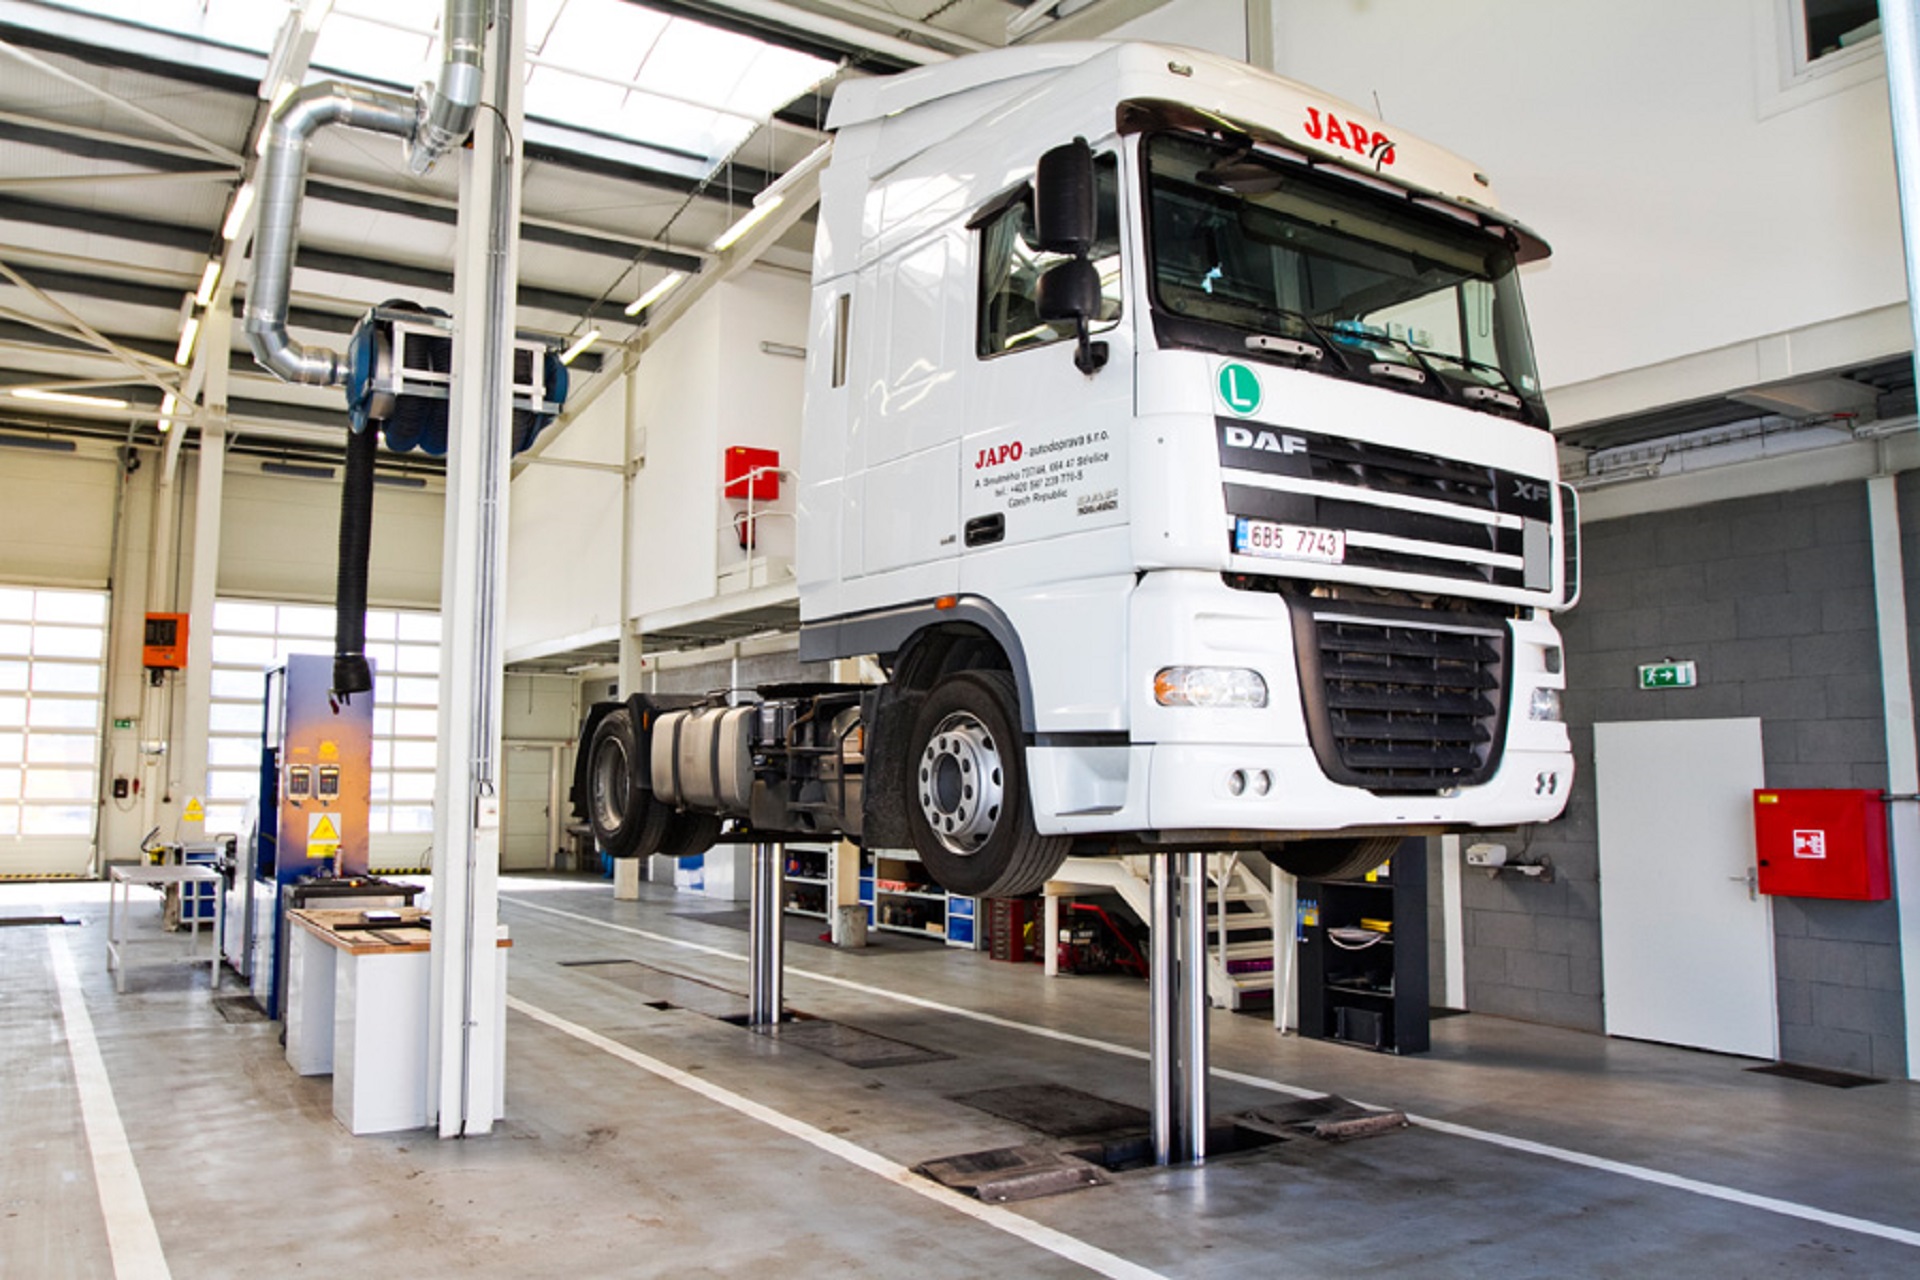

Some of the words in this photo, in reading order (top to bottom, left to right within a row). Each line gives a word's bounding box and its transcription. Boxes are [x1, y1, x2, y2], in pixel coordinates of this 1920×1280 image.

[1304, 107, 1395, 165] JAPO
[1228, 368, 1252, 407] L
[1225, 426, 1308, 455] DAF
[975, 441, 1022, 469] JAPO
[1512, 479, 1548, 501] XF
[1296, 529, 1337, 556] 7743
